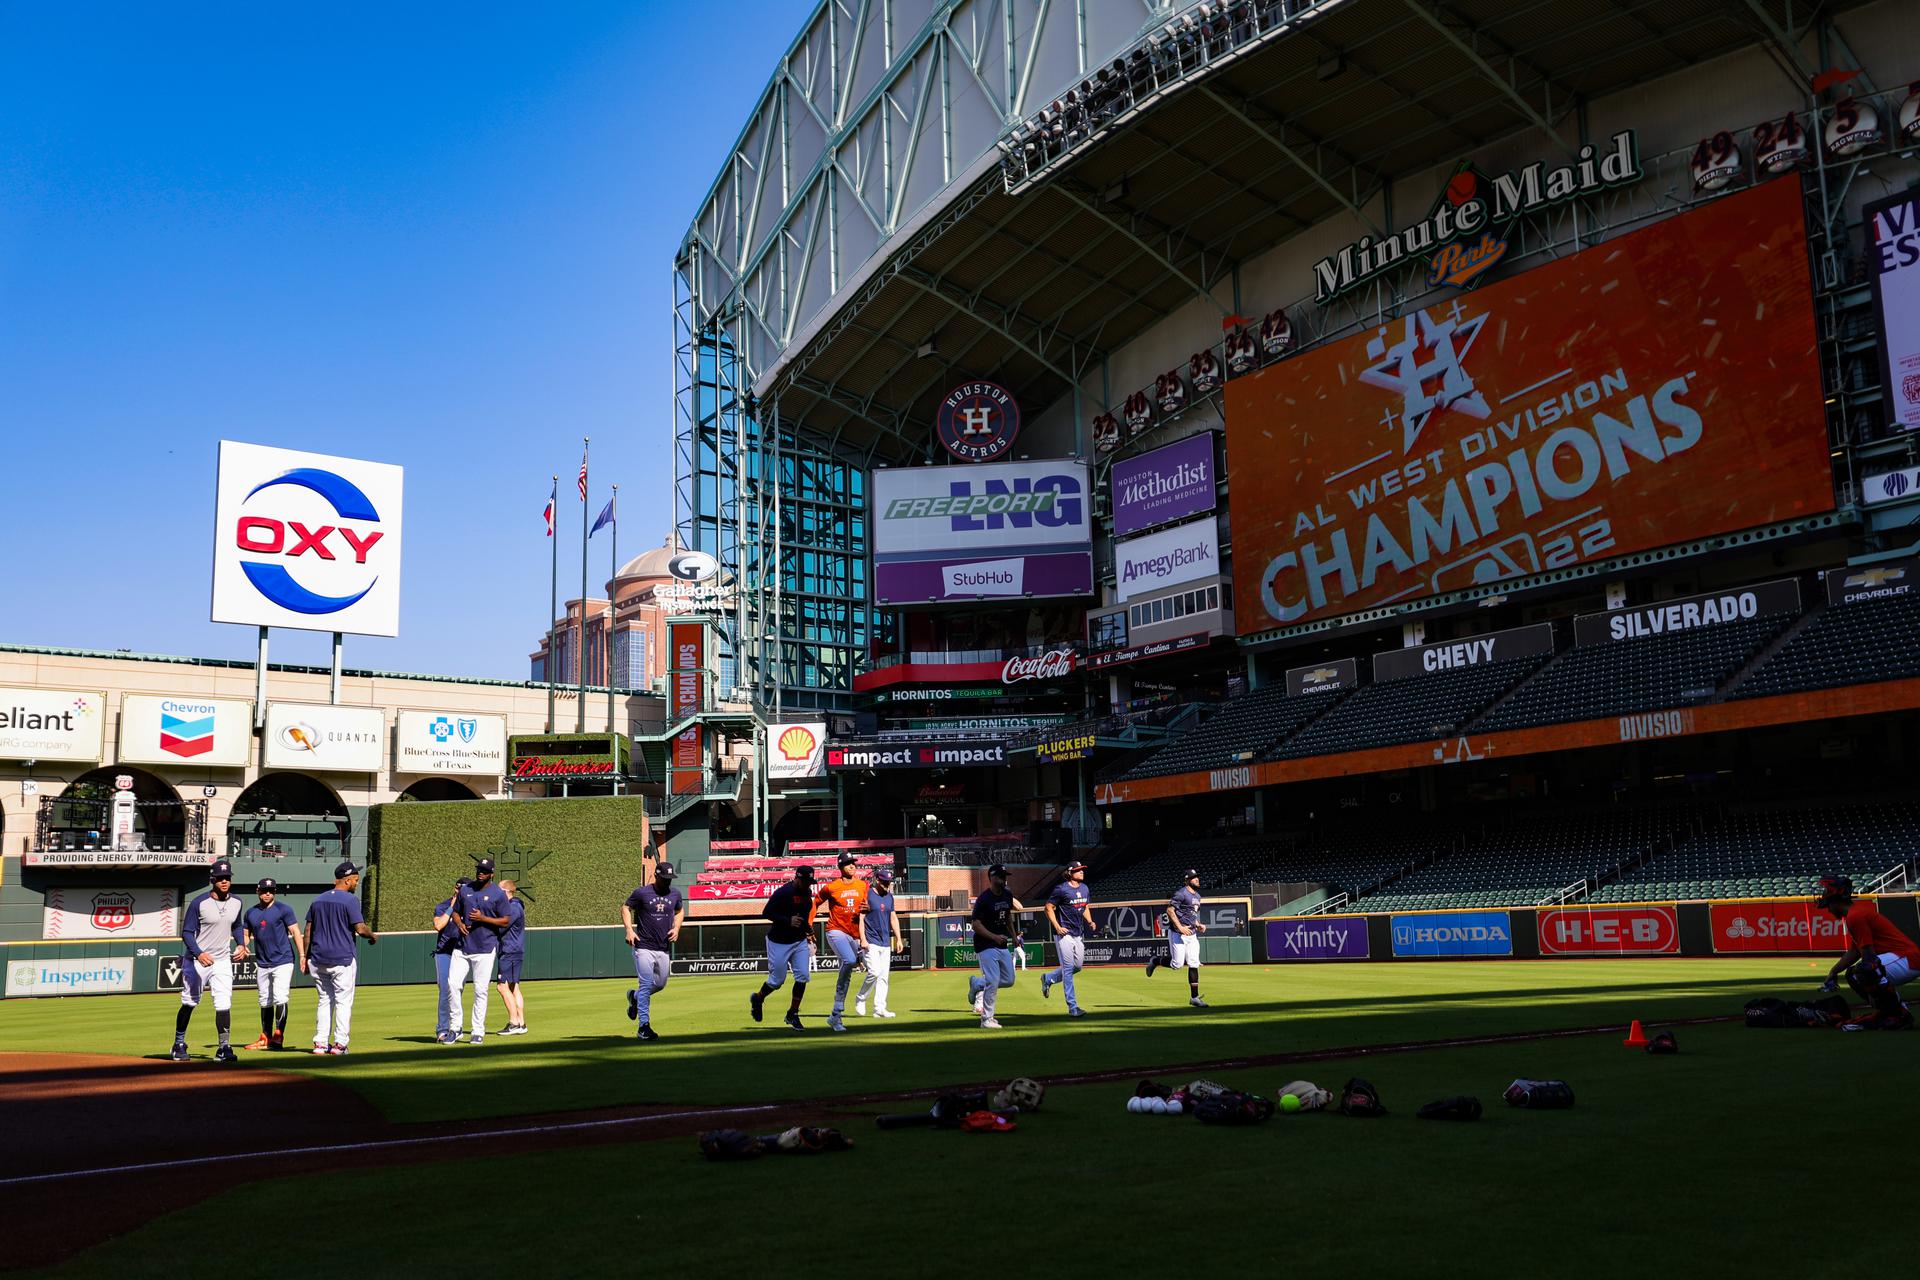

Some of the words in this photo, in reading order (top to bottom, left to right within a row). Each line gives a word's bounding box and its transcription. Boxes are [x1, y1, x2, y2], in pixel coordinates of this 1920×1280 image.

[1836, 97, 1859, 133] 5
[1754, 112, 1799, 156] 24
[1830, 130, 1873, 151] BAGWELL
[1691, 131, 1733, 170] 49
[1767, 150, 1793, 164] WYN
[1314, 199, 1481, 303] Minute
[1491, 130, 1637, 219] Maid
[1429, 232, 1510, 287] Park
[947, 384, 1009, 408] HOUSTON
[963, 407, 992, 435] H
[950, 437, 1006, 457] ASTROS
[1293, 504, 1336, 538] AL
[1347, 448, 1444, 510] WEST
[1460, 367, 1629, 461] DIVISION
[1118, 471, 1153, 487] HOUSTON
[1120, 462, 1208, 507] Methodist
[889, 491, 1053, 518] FREEPORT
[950, 474, 1082, 532] LNG
[1143, 497, 1172, 511] LEADING
[1174, 485, 1208, 502] MEDICINE
[1261, 375, 1703, 623] CHAMPIONS
[236, 516, 385, 564] OXY
[1542, 519, 1615, 569] 22
[1122, 542, 1210, 583] AmegyBank
[953, 570, 1013, 586] StubHub
[653, 583, 732, 600] Gallagher
[1843, 583, 1912, 604] CHEVROLET
[660, 600, 725, 610] INSURANCE
[1610, 592, 1758, 640] SILVERADO
[1144, 643, 1170, 655] Cantina
[1423, 638, 1496, 672] CHEVY
[892, 689, 953, 700] HORNITOS
[1302, 681, 1341, 694] CHEVROLET
[161, 701, 216, 714] Chevron
[959, 718, 1029, 729] HORNITOS
[22, 740, 73, 753] company
[328, 731, 377, 743] QUANTA
[1037, 735, 1096, 756] PLUCKERS
[404, 747, 450, 758] BlueCross
[452, 748, 500, 760] BlueShield
[843, 748, 912, 767] impact
[934, 745, 1003, 764] impact
[1052, 753, 1069, 762] WING
[433, 760, 443, 769] of
[445, 761, 472, 770] Texas
[513, 756, 615, 777] Budweiser
[43, 854, 94, 863] PROVIDING
[97, 854, 134, 863] ENERGY.
[136, 854, 184, 863] IMPROVING
[185, 855, 207, 863] LIVES.
[97, 896, 130, 906] PHILLIPS
[97, 908, 128, 924] 66
[1812, 916, 1847, 936] Far
[1284, 924, 1348, 954] xfinity
[1415, 926, 1509, 943] HONDA
[1555, 918, 1660, 943] H-E-B
[136, 948, 157, 956] 399
[1084, 947, 1113, 956] ermania
[41, 966, 125, 986] Insperity
[688, 960, 759, 973] NITTOTIRE.COM
